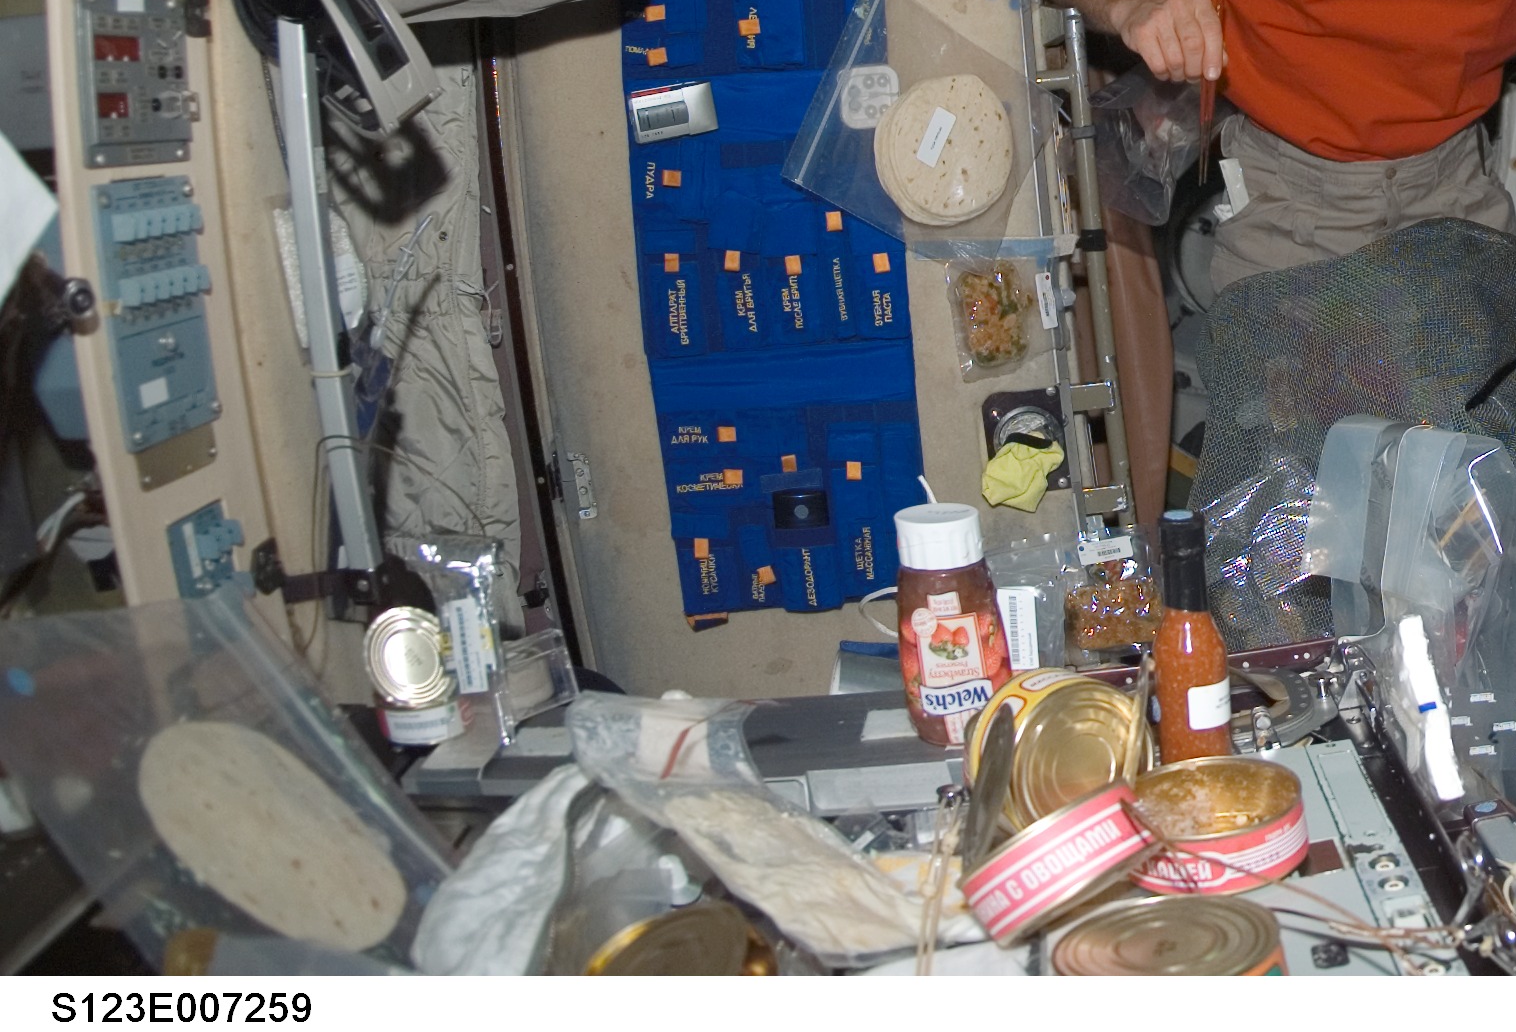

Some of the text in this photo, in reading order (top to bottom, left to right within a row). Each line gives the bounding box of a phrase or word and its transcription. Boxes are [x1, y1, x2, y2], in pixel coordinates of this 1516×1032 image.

[646, 161, 656, 199] ПУДРА
[669, 288, 679, 333] АППАРАТ
[677, 279, 689, 345] БРИТВЕННЫЙ
[735, 290, 745, 316] КРЕМ
[781, 288, 792, 312] КРЕМ
[882, 292, 892, 323] ПАСТА
[748, 311, 758, 332] ДЛЯ
[671, 434, 709, 445] ДЛЯ РУК
[802, 548, 818, 607] ДЕЗОДОРАНТ
[928, 668, 981, 681] Strawberry
[925, 685, 990, 711] Welch's
[1020, 818, 1123, 890] ОВОЩАМИ
